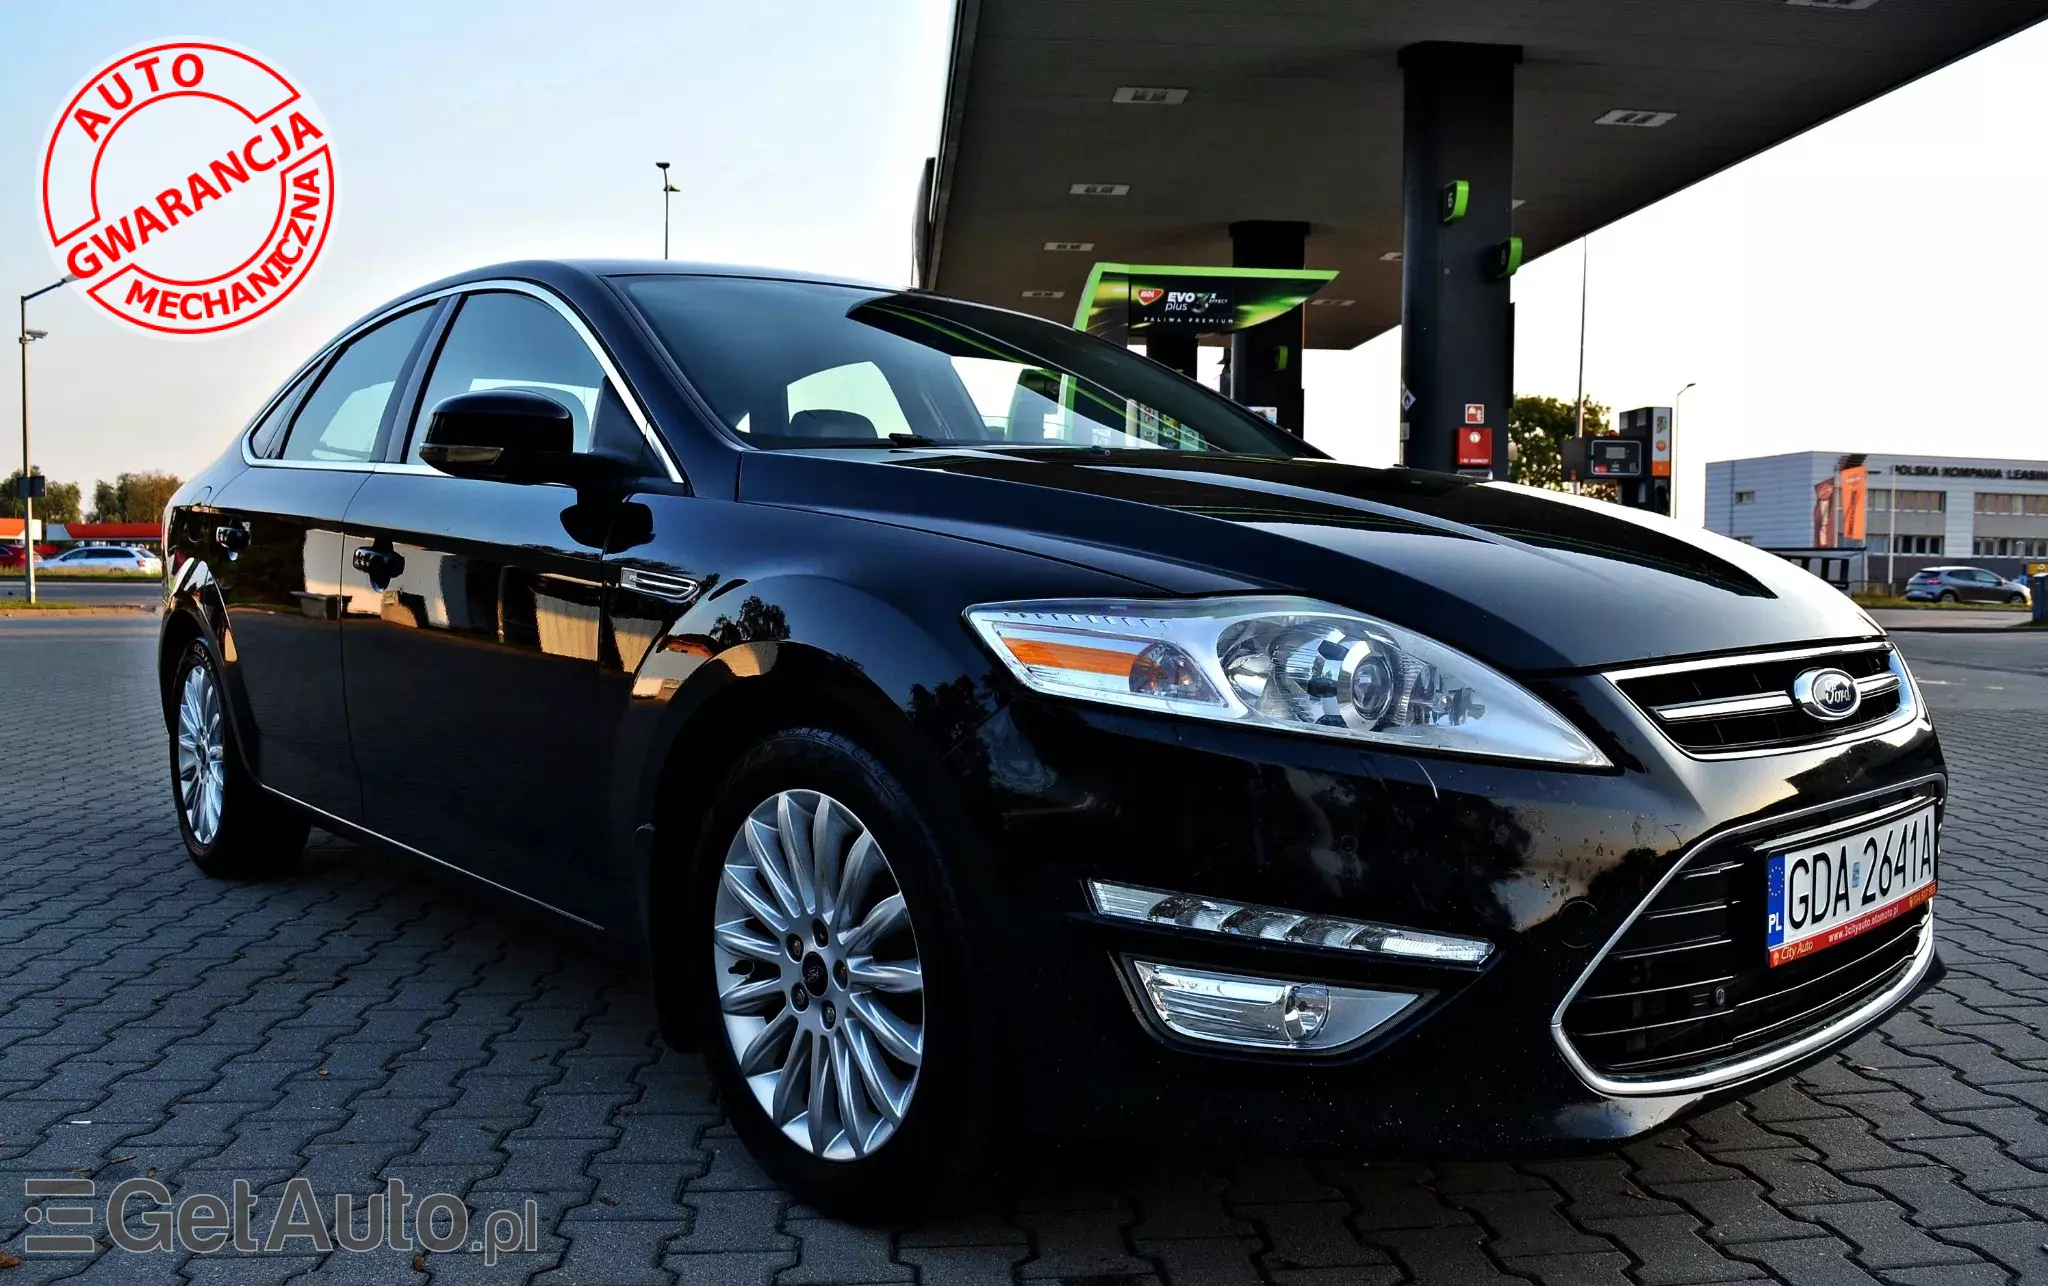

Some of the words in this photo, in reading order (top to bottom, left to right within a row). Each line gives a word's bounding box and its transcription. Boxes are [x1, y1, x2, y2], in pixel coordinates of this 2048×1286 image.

[1165, 300, 1188, 312] plus
[1167, 291, 1196, 303] EVO
[1824, 680, 1851, 705] Ford
[1788, 845, 1851, 930] GDA
[1861, 814, 1932, 907] 2641A
[1768, 912, 1783, 934] PL
[1796, 940, 1814, 956] Auto
